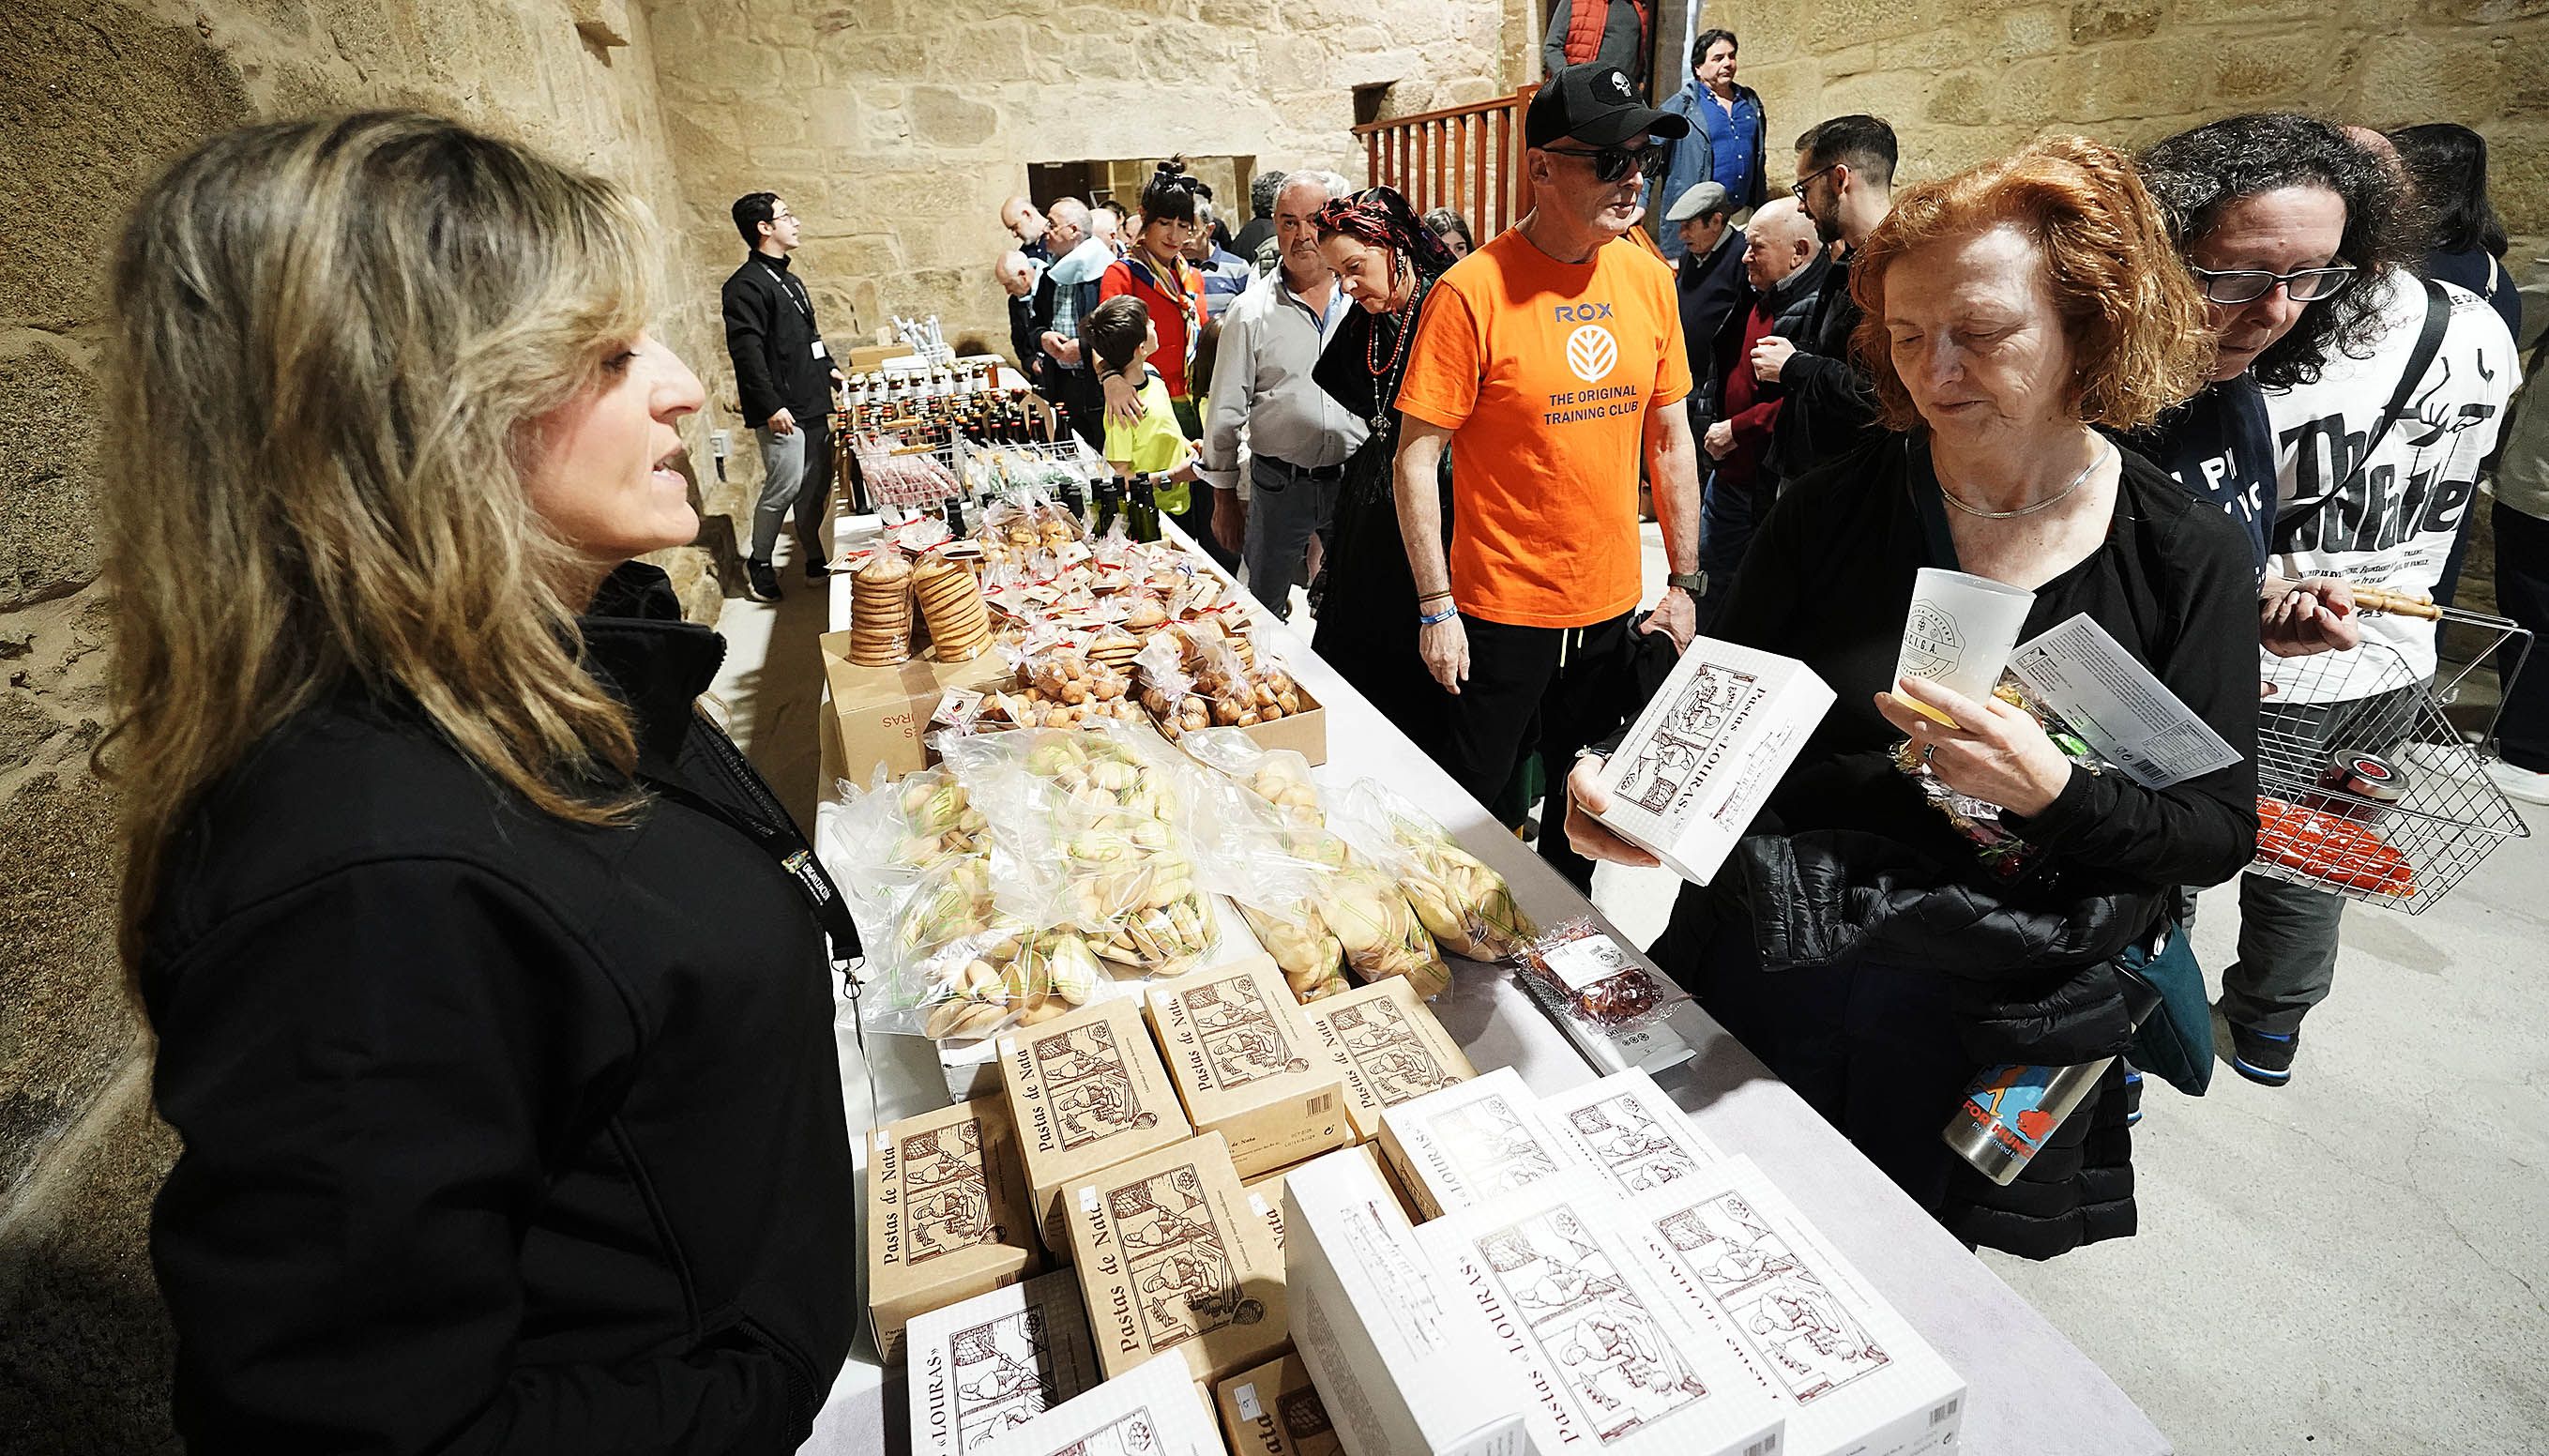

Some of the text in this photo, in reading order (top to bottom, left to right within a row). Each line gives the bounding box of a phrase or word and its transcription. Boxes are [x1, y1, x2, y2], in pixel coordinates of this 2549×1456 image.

[1555, 302, 1614, 322] ROX
[1544, 401, 1638, 425] TRAINING CLUB
[1549, 385, 1637, 407] THE ORIGINAL
[1730, 687, 1767, 732] Pastas
[1176, 1031, 1194, 1045] de
[1188, 1051, 1213, 1092] Pastas
[1315, 1020, 1376, 1109] Pastas de Nata
[1017, 1049, 1054, 1153] Pastas de Nata
[1963, 1099, 1992, 1127] FOR
[879, 1146, 899, 1266] Pastas de Nata
[1097, 1254, 1119, 1277] de
[1110, 1285, 1141, 1355] Pastas
[1526, 1369, 1582, 1446] Pastas
[1257, 1411, 1286, 1456] ata
